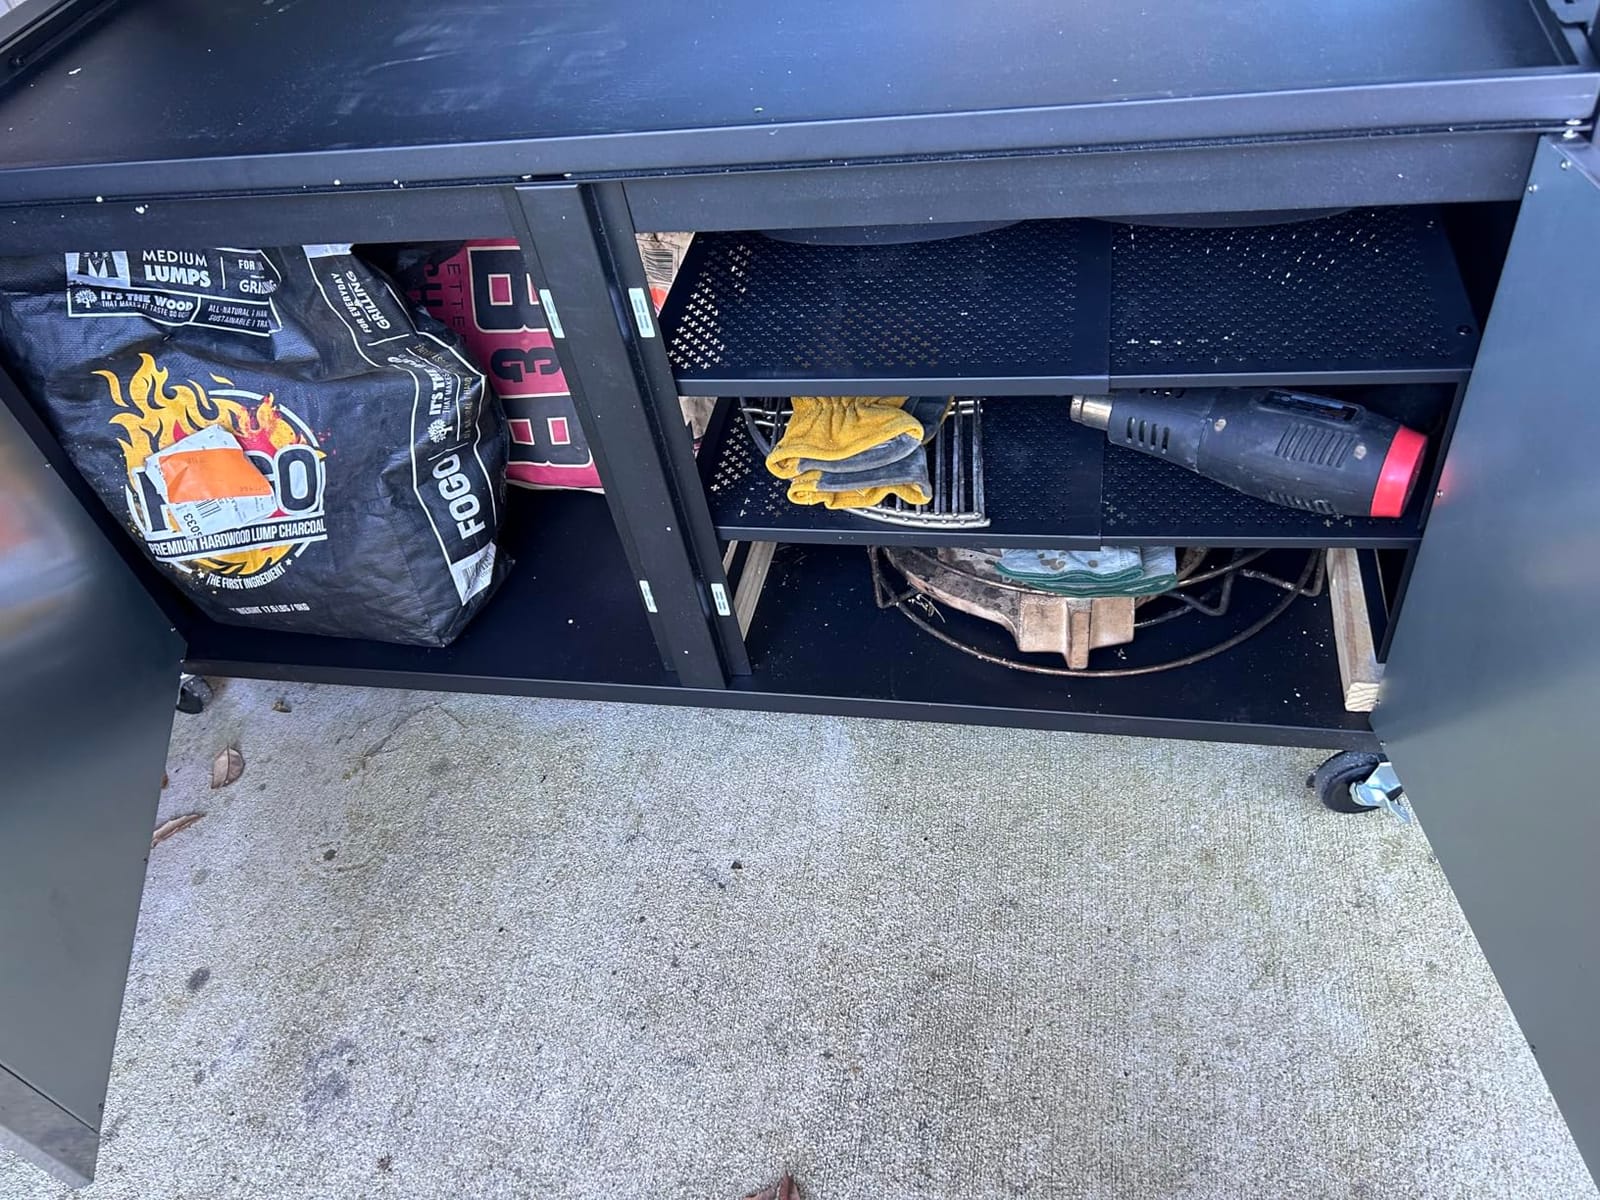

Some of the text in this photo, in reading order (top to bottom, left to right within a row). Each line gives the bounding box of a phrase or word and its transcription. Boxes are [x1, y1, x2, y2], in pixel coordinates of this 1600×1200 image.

[143, 250, 207, 267] MEDIUM
[238, 259, 255, 271] FOR
[144, 265, 211, 287] LUMPS
[101, 291, 193, 311] IT'S THE WOOD
[150, 304, 168, 316] TASTE
[331, 272, 372, 333] FOR EVERYDAY
[346, 270, 390, 329] GRILLING
[208, 304, 249, 317] ALL-NATURAL
[208, 314, 251, 327] SUSTAINABLE
[429, 391, 444, 416] IT'S
[442, 397, 451, 414] THAT
[432, 453, 486, 540] FOGO
[148, 518, 327, 556] PREMIUM HARDWOOD LUMP CHARCOAL
[206, 562, 286, 590] THE FIRST INGREDIENT
